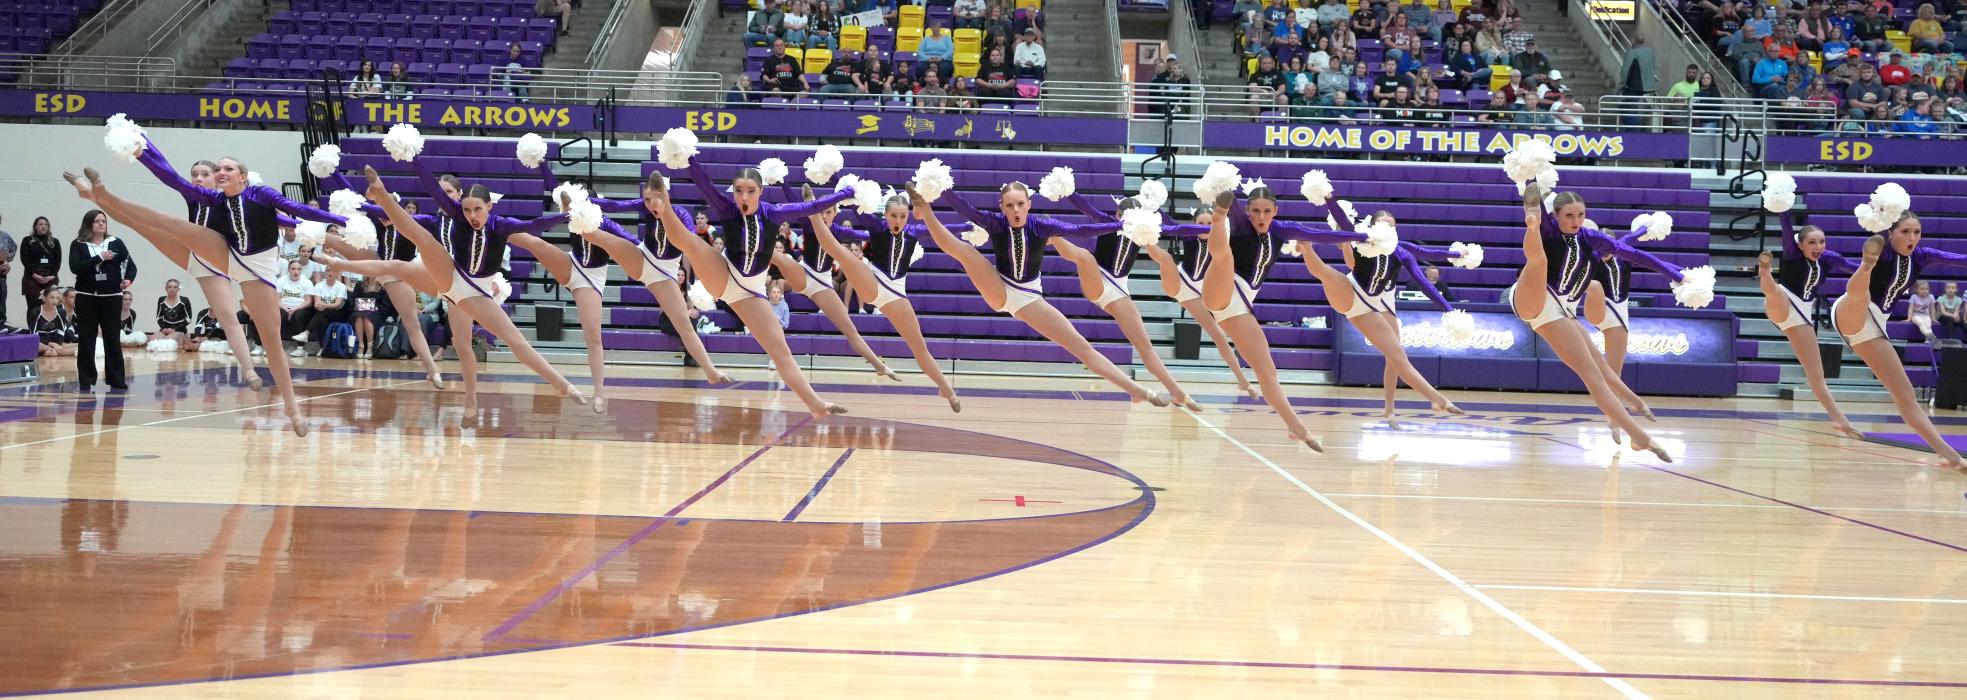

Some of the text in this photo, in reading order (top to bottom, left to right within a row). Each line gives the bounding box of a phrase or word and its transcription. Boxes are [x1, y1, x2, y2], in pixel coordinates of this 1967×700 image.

[35, 93, 86, 113] ESD
[199, 97, 290, 120] HOME
[363, 102, 422, 123] THE
[440, 104, 571, 127] ARROWS
[685, 111, 738, 131] ESD
[1264, 124, 1362, 150] HOME
[1369, 129, 1412, 151] OF
[1416, 130, 1481, 153] THE
[1821, 140, 1874, 161] ESD
